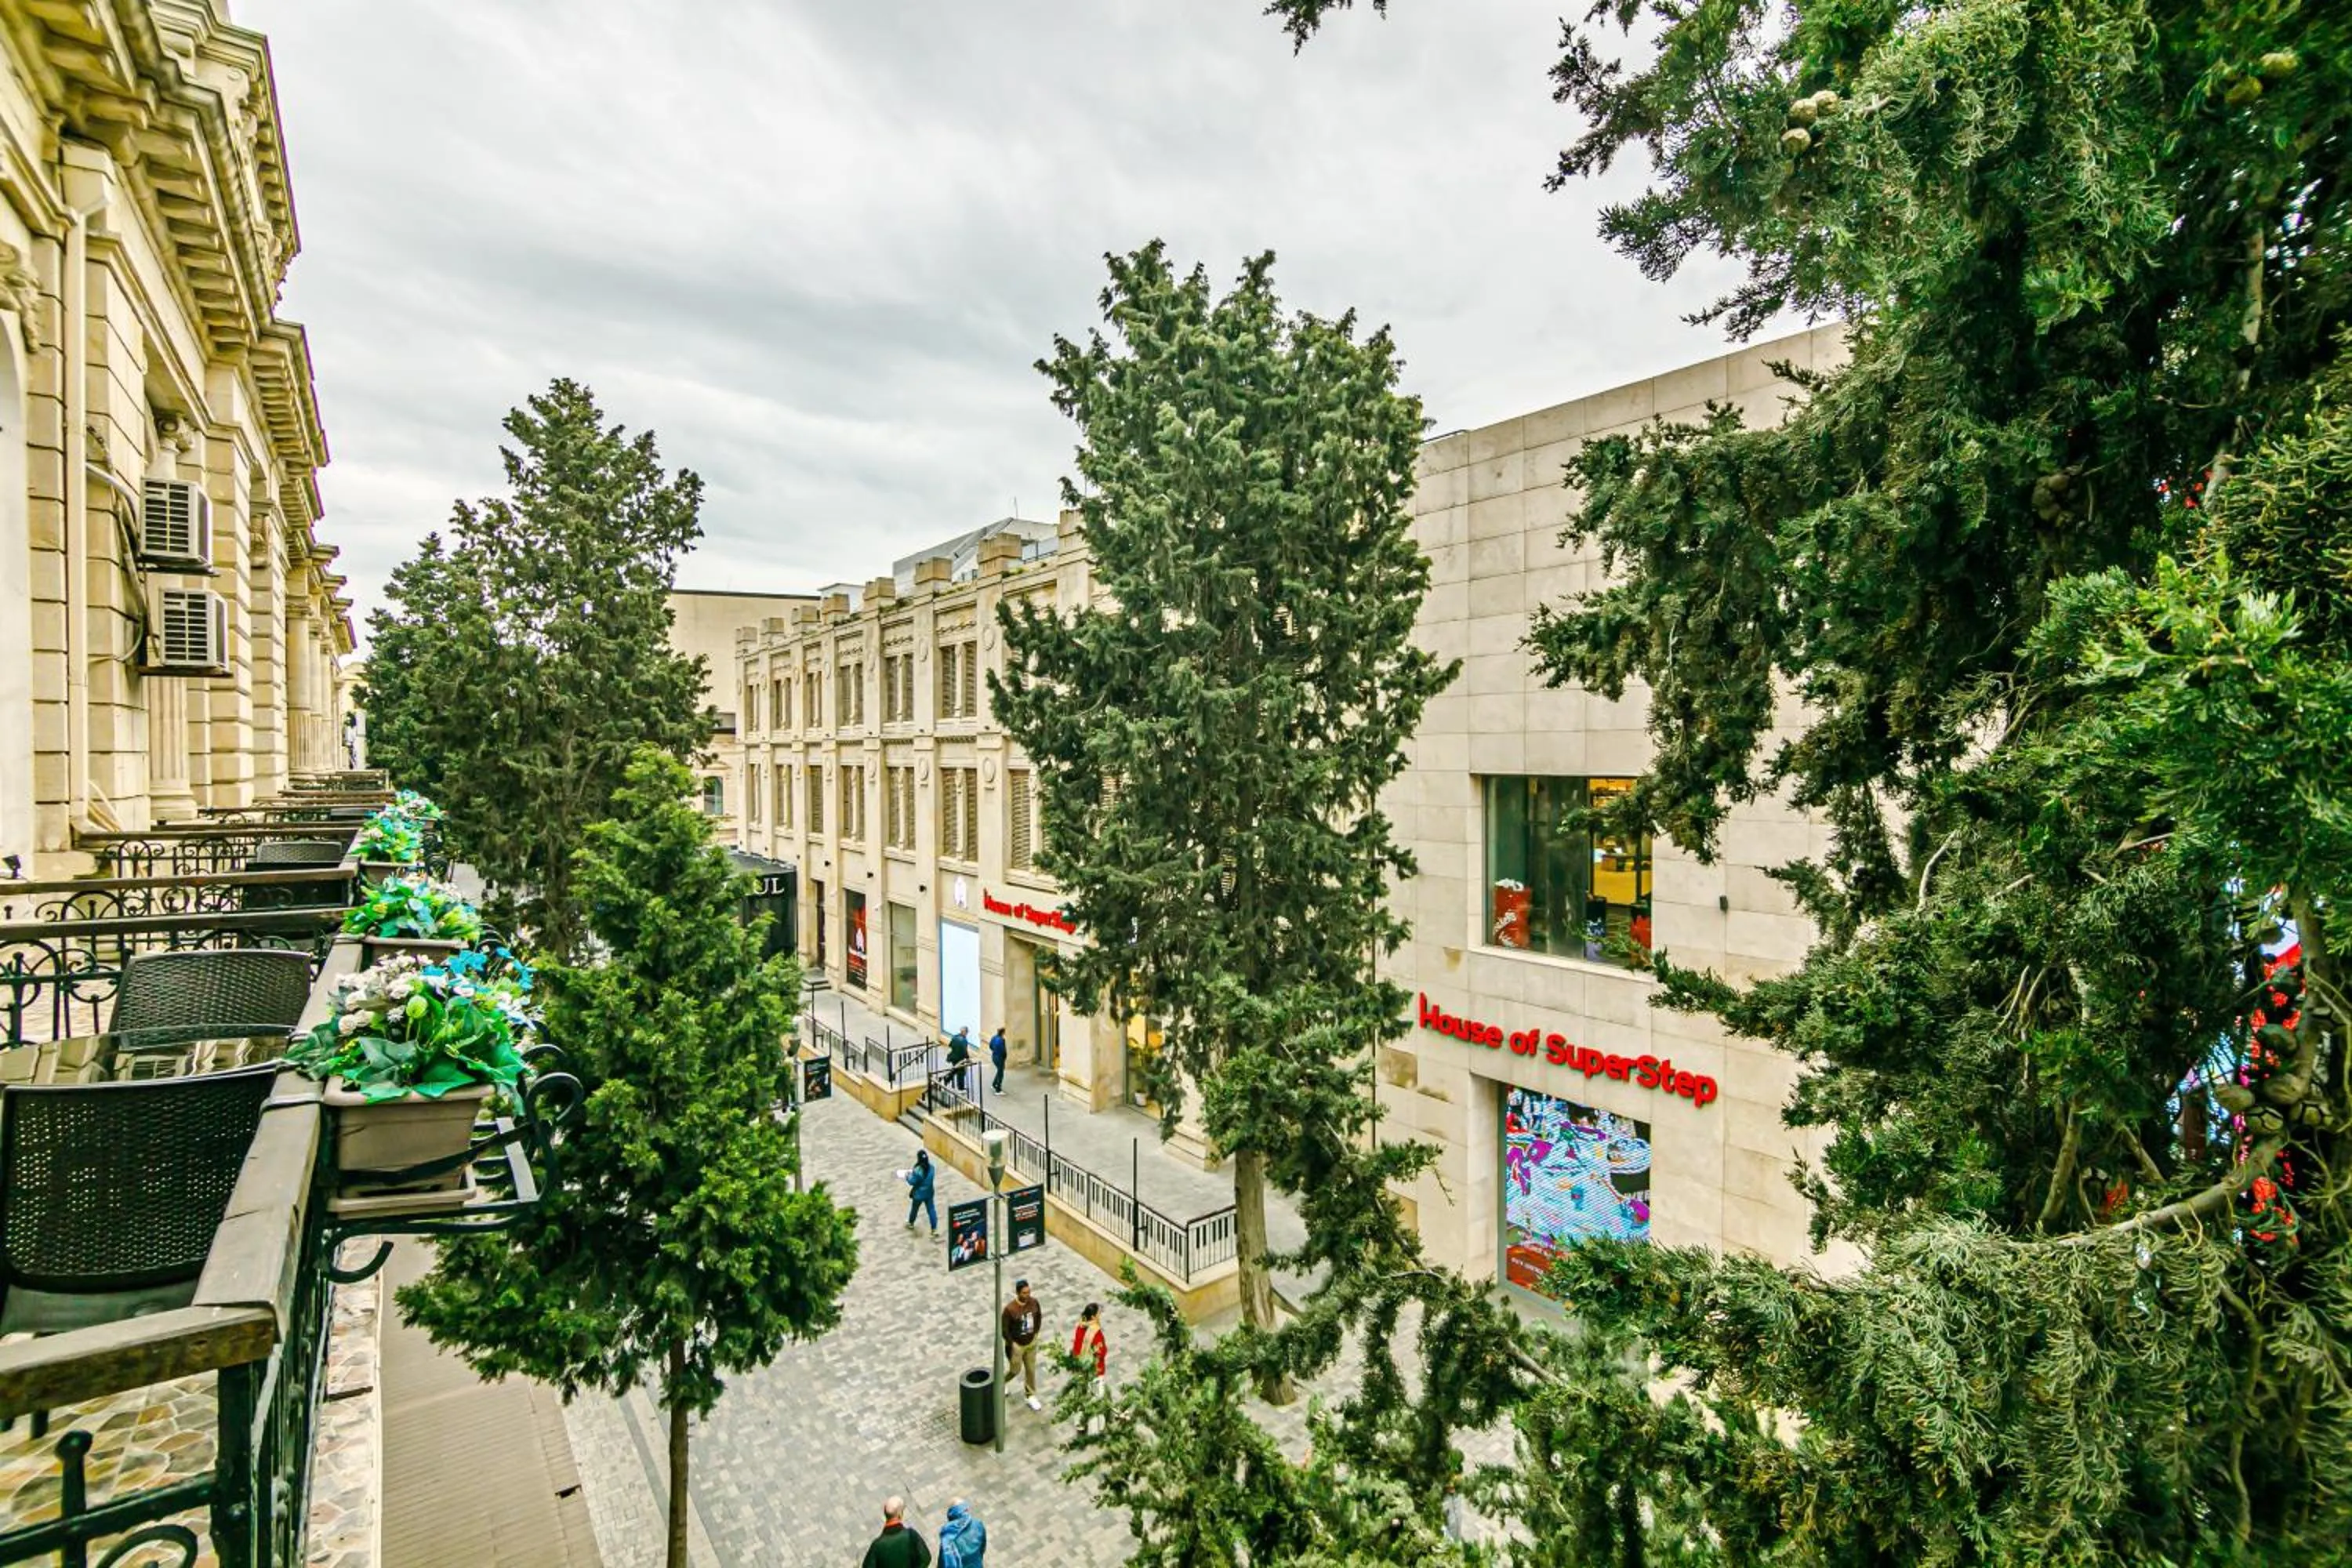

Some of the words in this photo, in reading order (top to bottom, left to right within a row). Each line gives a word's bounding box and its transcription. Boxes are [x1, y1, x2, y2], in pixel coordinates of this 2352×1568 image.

[1419, 992, 1504, 1049] House
[1508, 1029, 1541, 1056] of
[1545, 1033, 1718, 1109] SuperStep
